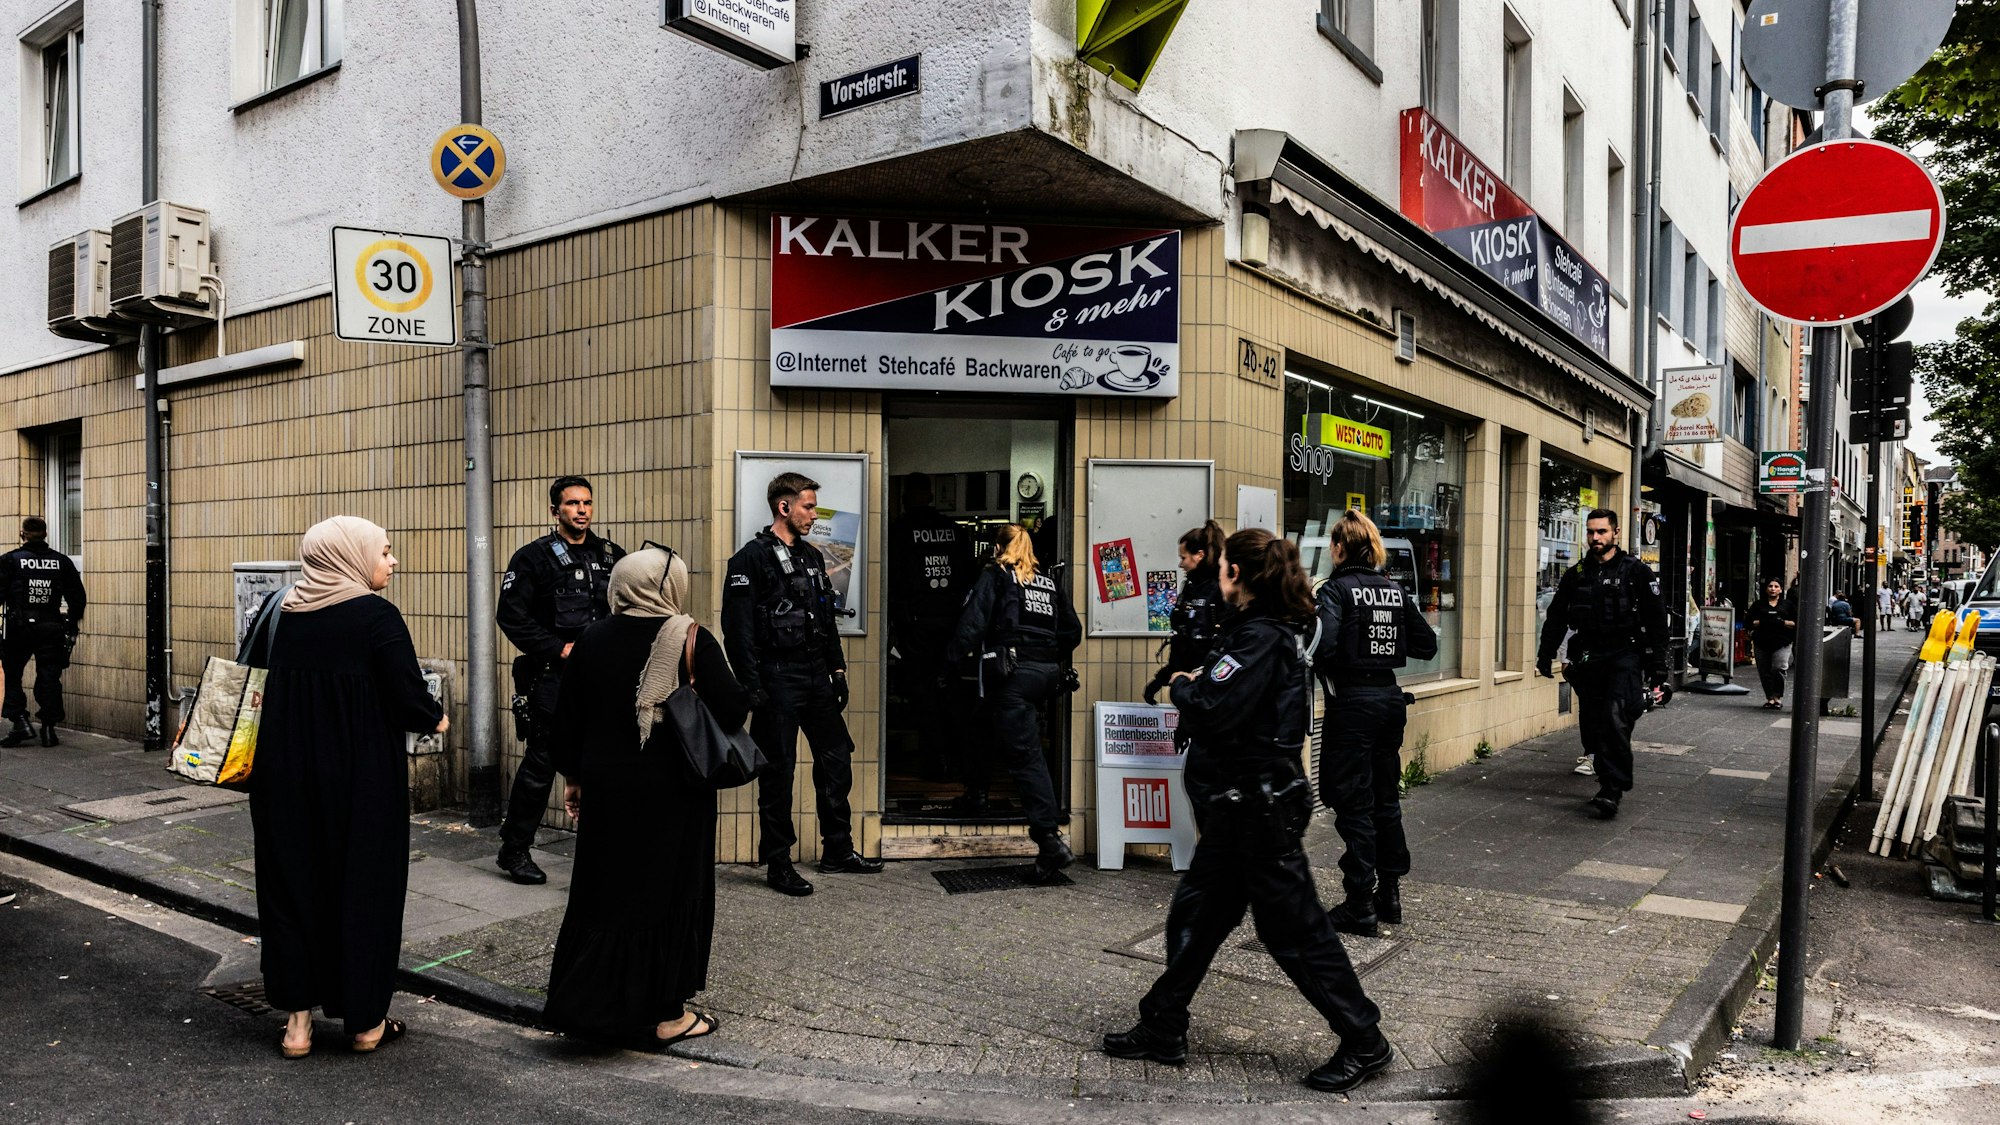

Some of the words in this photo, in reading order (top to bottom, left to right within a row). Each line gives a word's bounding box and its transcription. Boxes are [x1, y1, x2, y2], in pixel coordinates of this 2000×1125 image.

[830, 64, 907, 105] Vorsterstr.
[1422, 114, 1497, 220] KALKER
[778, 214, 1031, 265] KALKER
[1470, 220, 1533, 267] KIOSK
[1503, 267, 1510, 288] &
[1511, 258, 1537, 286] mehr
[1554, 245, 1583, 286] Stehcafé
[372, 258, 417, 294] 30
[933, 237, 1169, 331] KIOSK
[1044, 308, 1068, 333] &
[1074, 284, 1172, 326] mehr
[367, 315, 427, 337] ZONE
[1052, 343, 1079, 363] Café
[1083, 345, 1094, 357] to
[1096, 347, 1110, 362] go
[878, 354, 956, 377] Stehcafé
[965, 358, 1062, 381] Backwaren
[1335, 423, 1356, 446] WEST
[1362, 437, 1384, 451] LOTTO
[1290, 432, 1334, 486] Shop
[1903, 487, 1913, 546] MITTLER
[811, 528, 832, 537] Spirale
[912, 529, 956, 543] POLIZEI
[20, 558, 60, 570] POLIZEI
[924, 555, 949, 566] NRW
[924, 565, 952, 577] 31533
[28, 579, 52, 588] NRW
[28, 587, 52, 596] 31531
[28, 595, 50, 604] BeSi
[1024, 588, 1051, 604] NRW
[1351, 587, 1404, 607] POLIZEI
[1025, 600, 1054, 616] 31533
[1372, 609, 1393, 624] NRW
[1368, 625, 1398, 640] 31531
[1370, 640, 1396, 656] BeSi
[1104, 713, 1116, 726] 22
[1117, 714, 1159, 727] Millionen
[1104, 741, 1134, 754] falsch!
[1126, 783, 1167, 823] Bild
